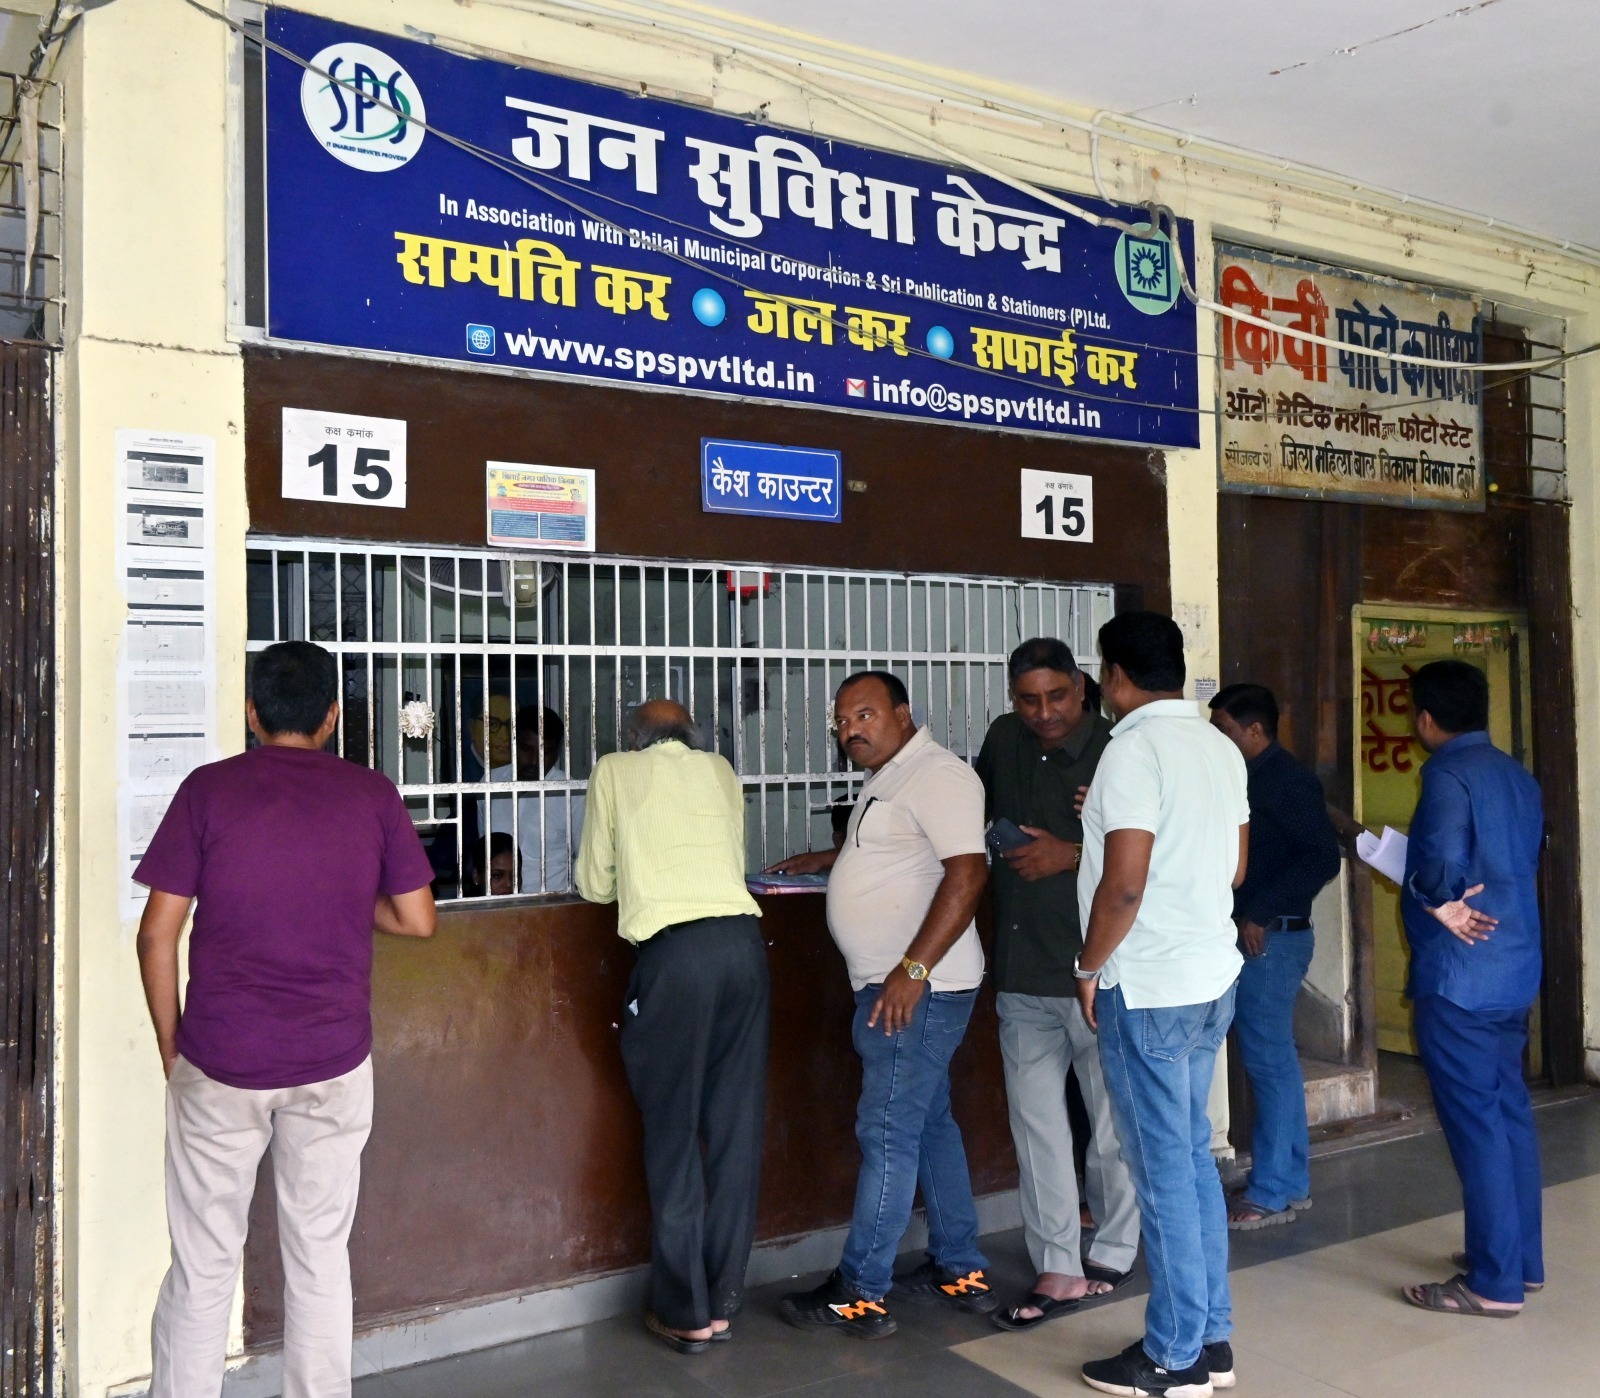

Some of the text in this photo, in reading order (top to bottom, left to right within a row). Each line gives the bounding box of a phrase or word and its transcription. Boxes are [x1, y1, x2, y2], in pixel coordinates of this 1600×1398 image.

[328, 57, 407, 144] SPS
[332, 143, 356, 152] ENABLED
[357, 147, 381, 156] SERVICES
[382, 152, 407, 161] PROVIDER
[505, 96, 1065, 273] जन सुविधा केन्द्र
[439, 193, 1111, 330] In Association With Bhilai Municipal Corporation & Sri Publication & Stationers (P)Ltd.
[394, 231, 1138, 389] सम्पत्ति कर जल कर सफाई कर
[504, 331, 1101, 428] www.spspvtltd.in info@spspvtltd.in
[324, 426, 341, 436] कक्ष
[1276, 391, 1333, 430] मेटिक
[1335, 402, 1382, 438] मशीन
[1398, 412, 1439, 444] फोटो
[1439, 418, 1473, 449] स्टेट
[308, 443, 393, 500] 15
[711, 456, 833, 505] कैश काउन्टर
[1280, 434, 1314, 475] जिला
[1315, 440, 1353, 482] महिला
[1353, 451, 1377, 480] बाल
[1036, 494, 1085, 537] 15
